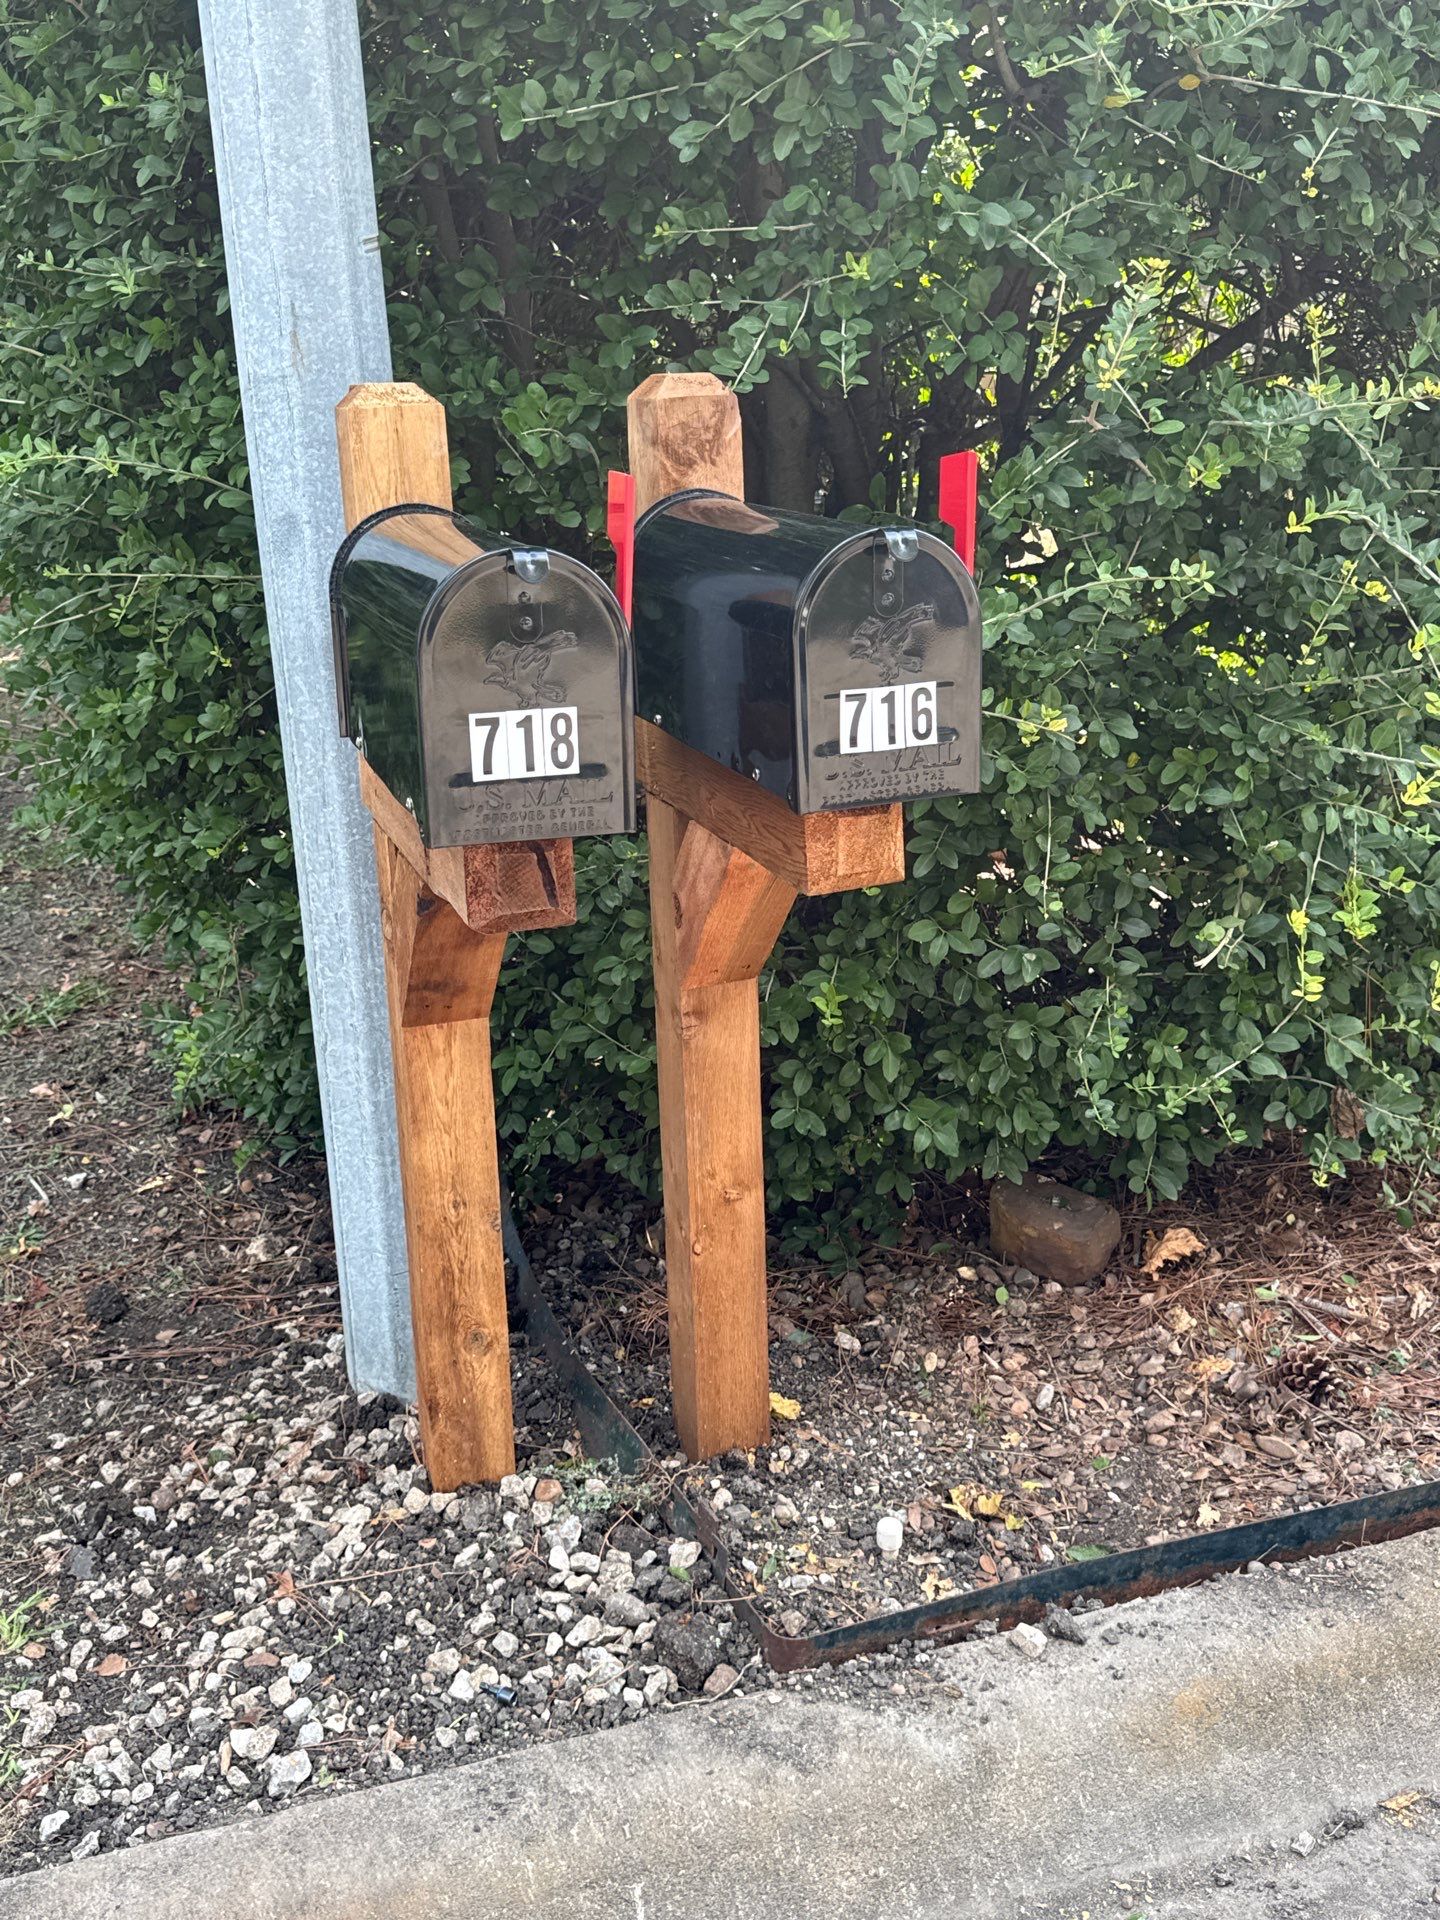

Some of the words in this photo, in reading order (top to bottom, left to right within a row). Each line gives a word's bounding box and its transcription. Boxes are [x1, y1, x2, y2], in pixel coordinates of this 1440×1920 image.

[845, 687, 932, 748] 716
[475, 712, 575, 775] 718
[522, 778, 614, 809] MAIL
[570, 805, 595, 818] THE
